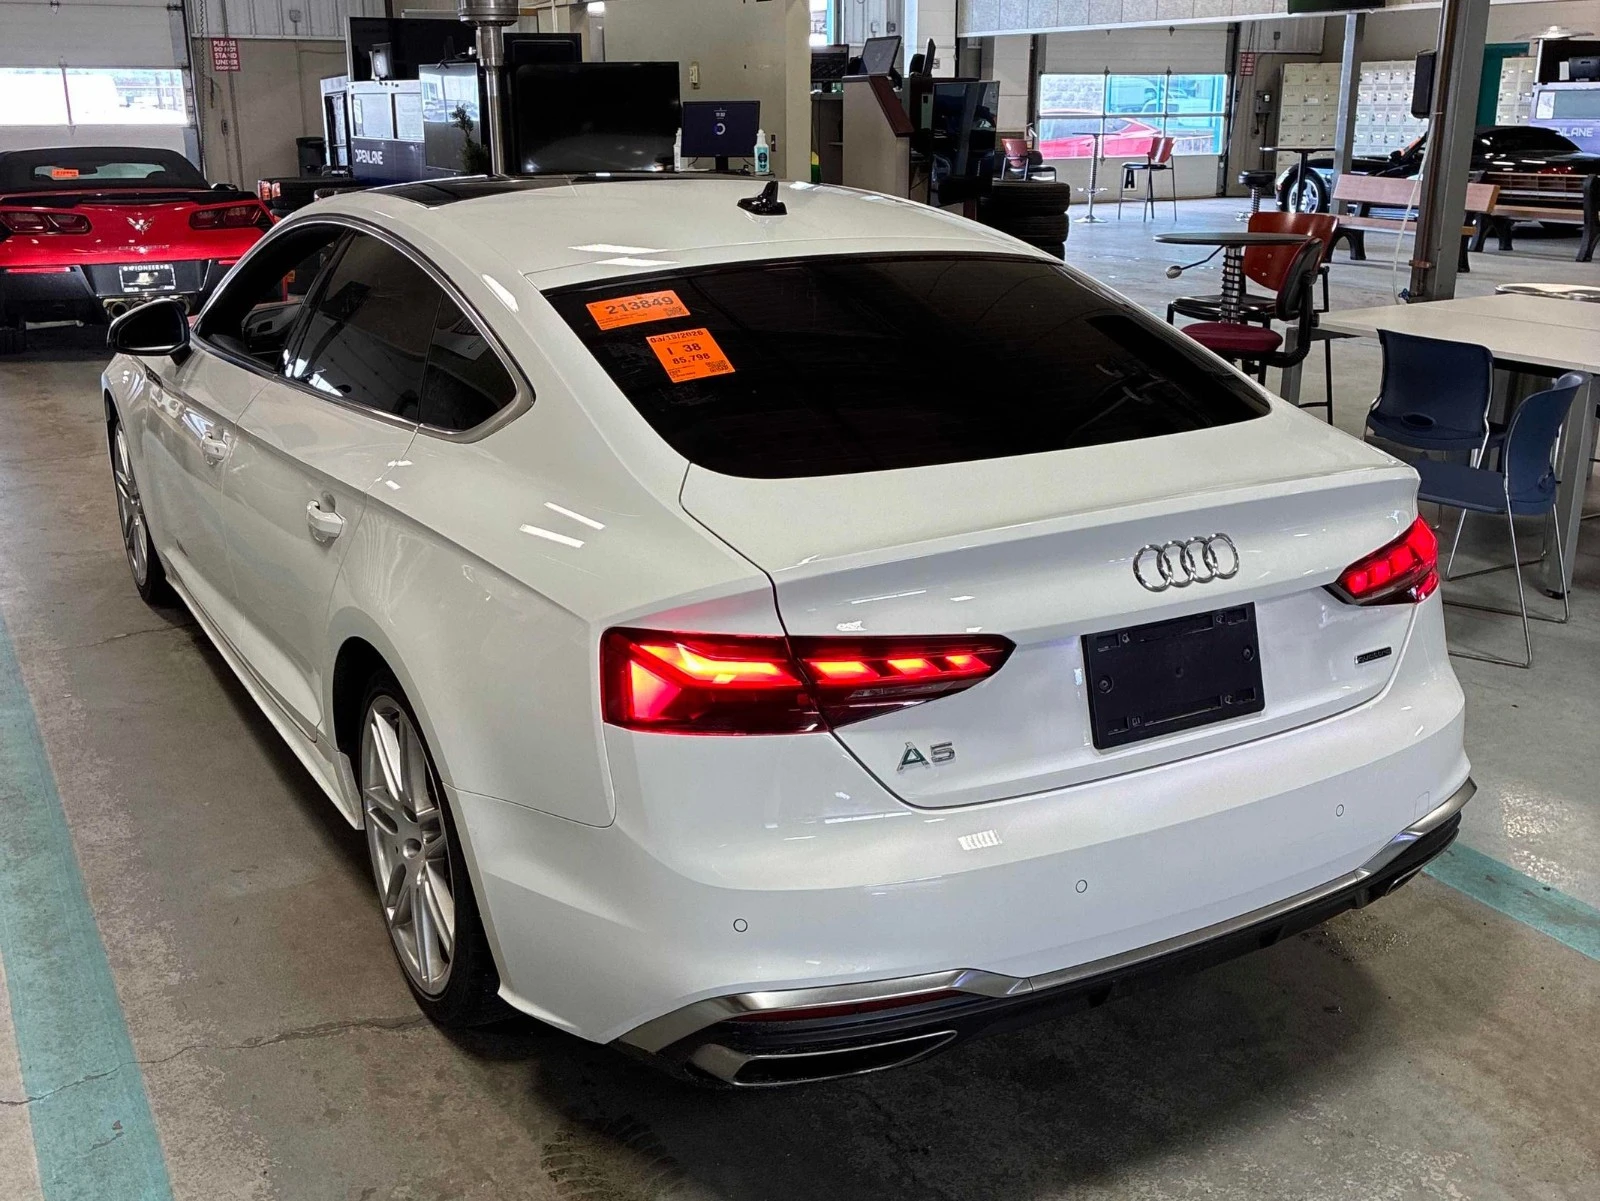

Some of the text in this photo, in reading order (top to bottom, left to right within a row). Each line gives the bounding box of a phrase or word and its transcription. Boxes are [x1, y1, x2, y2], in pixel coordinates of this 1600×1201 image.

[1124, 169, 1135, 189] A
[605, 296, 674, 315] 213849
[682, 343, 702, 352] 38
[896, 741, 956, 771] A5
